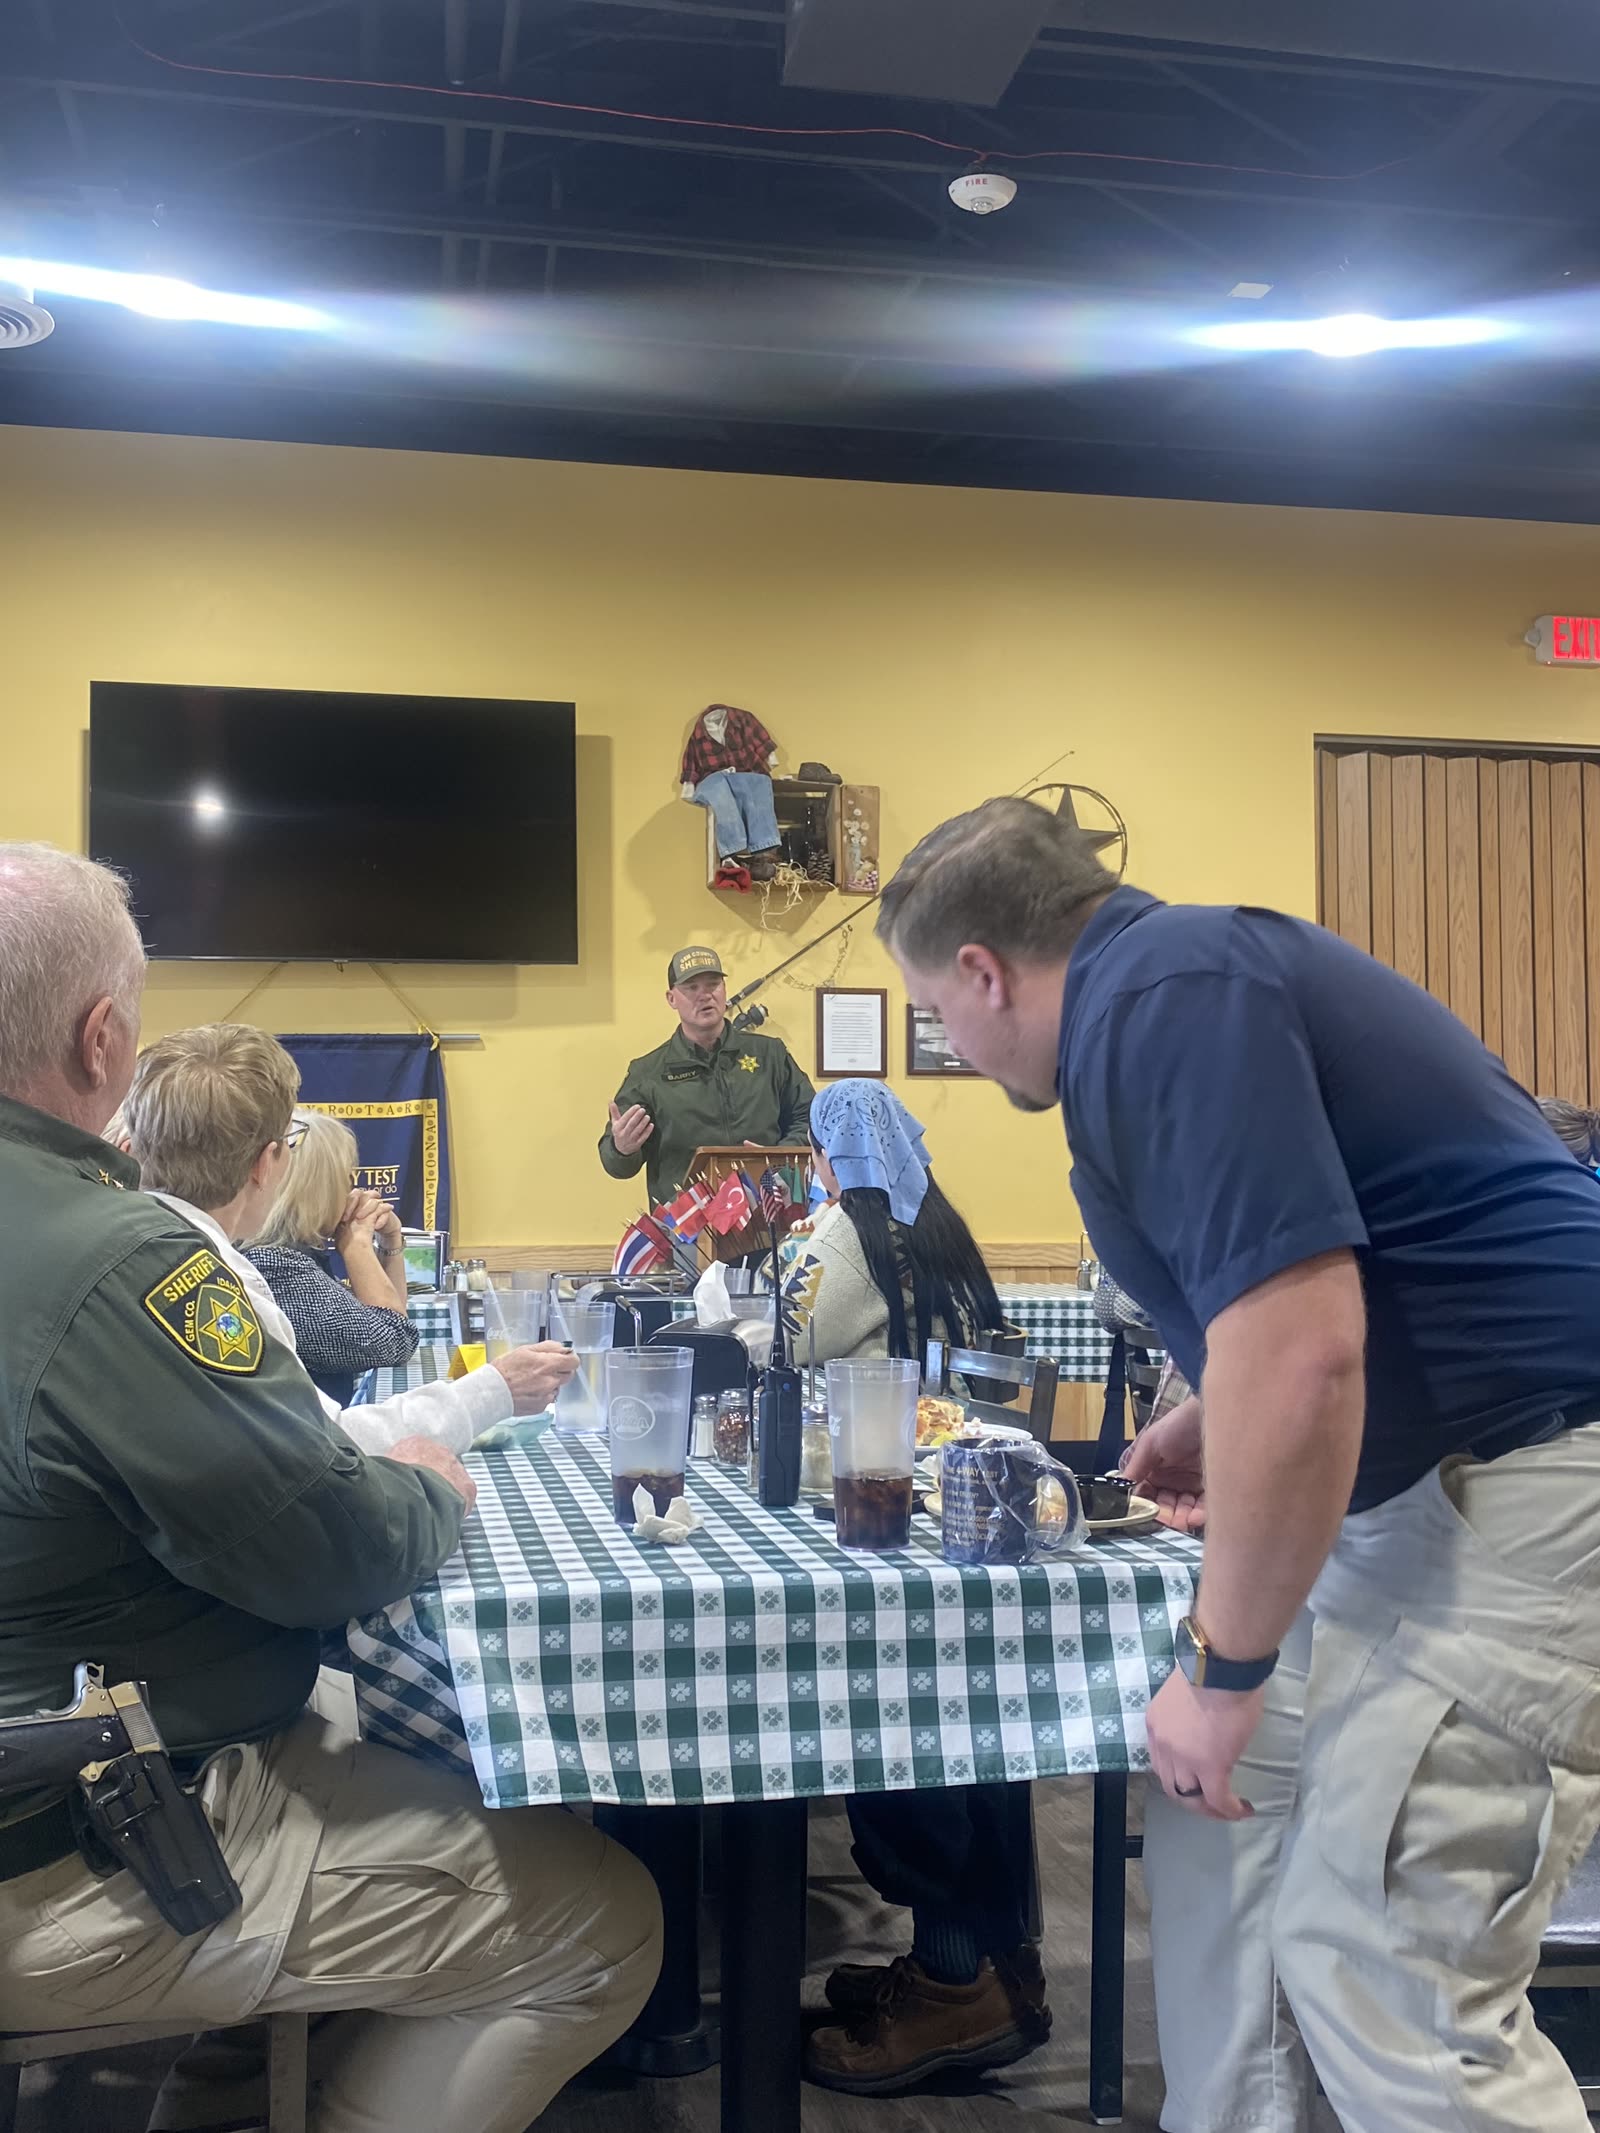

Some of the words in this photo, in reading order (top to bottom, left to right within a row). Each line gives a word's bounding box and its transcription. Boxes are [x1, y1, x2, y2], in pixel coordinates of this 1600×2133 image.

[965, 178, 988, 187] FIRE
[1553, 616, 1600, 660] EXIT
[364, 1168, 399, 1186] TEST
[385, 1184, 398, 1194] do
[163, 1255, 216, 1303] SHERIFF
[216, 1276, 241, 1296] IDAHO
[184, 1300, 196, 1318] CO.
[184, 1319, 196, 1342] GEM
